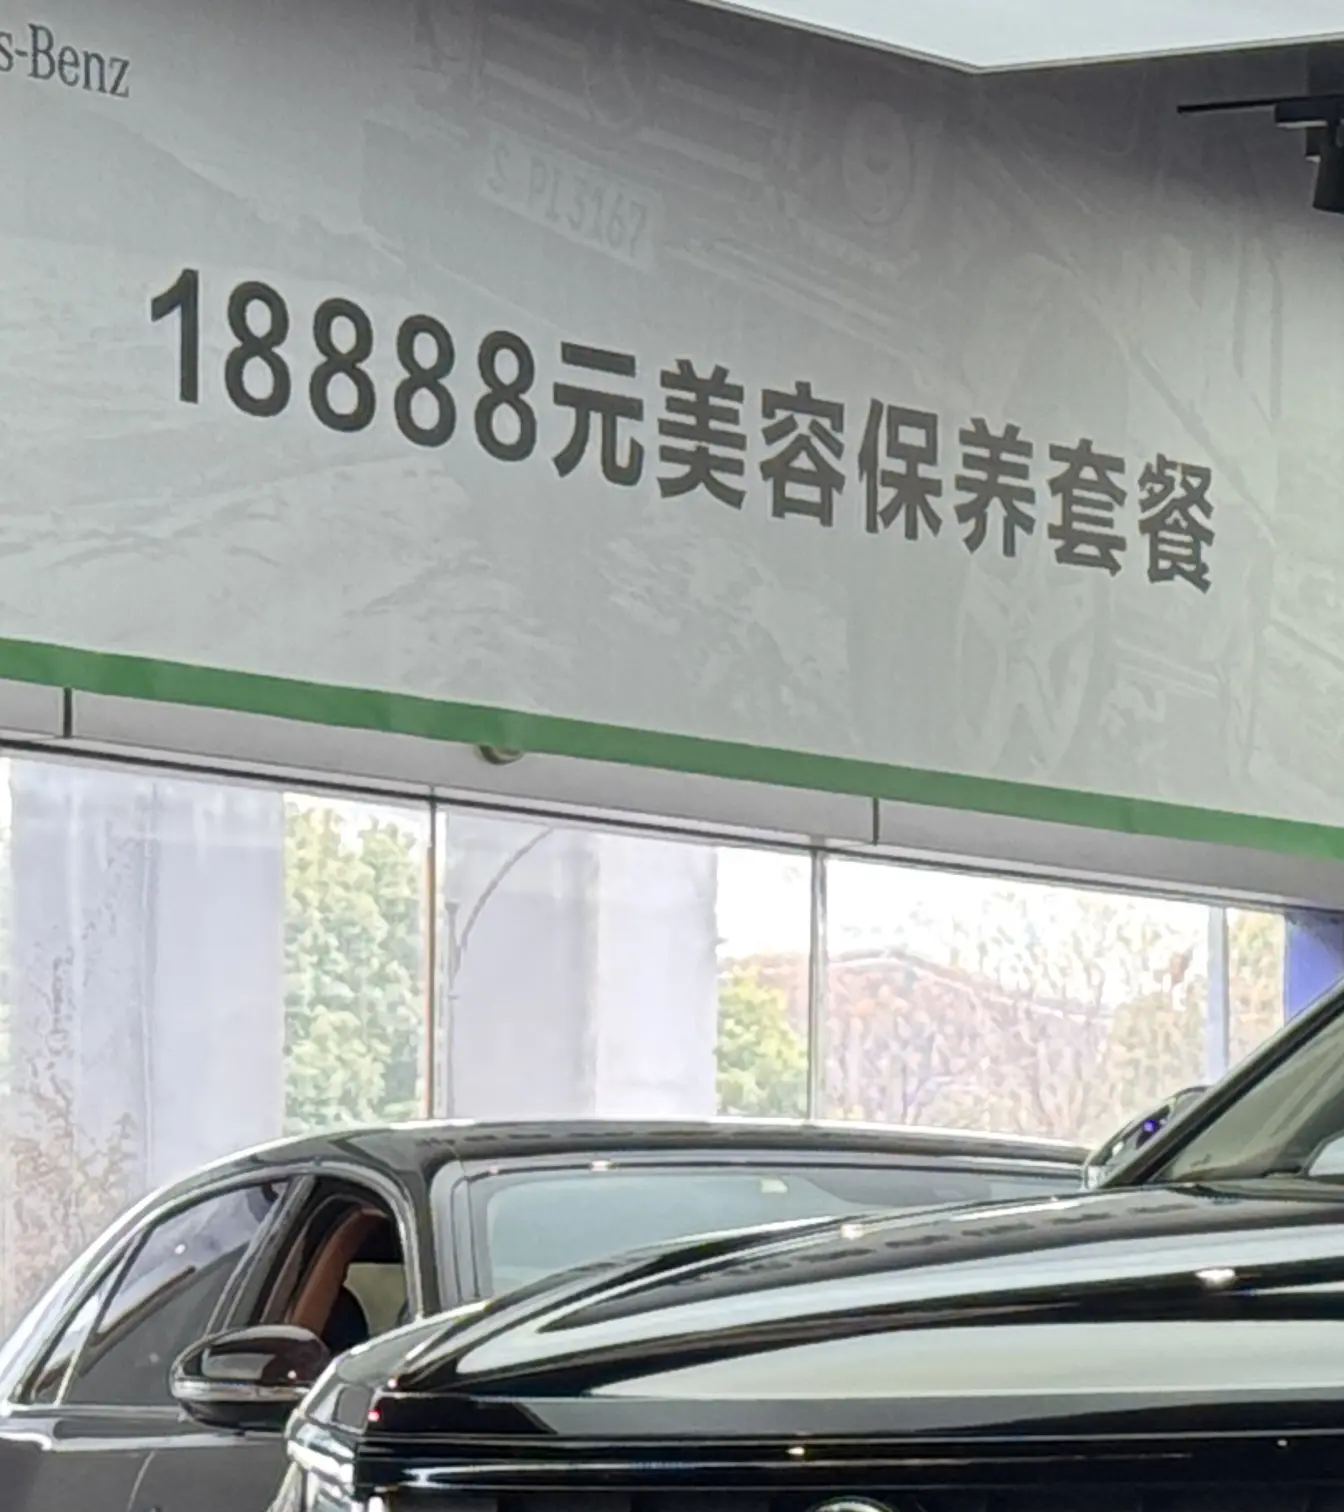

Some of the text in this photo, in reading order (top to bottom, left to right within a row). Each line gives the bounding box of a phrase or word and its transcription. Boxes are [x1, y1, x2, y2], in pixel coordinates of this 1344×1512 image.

[0, 22, 131, 98] s-Benz
[150, 267, 1216, 594] 18888元美容保养套餐
